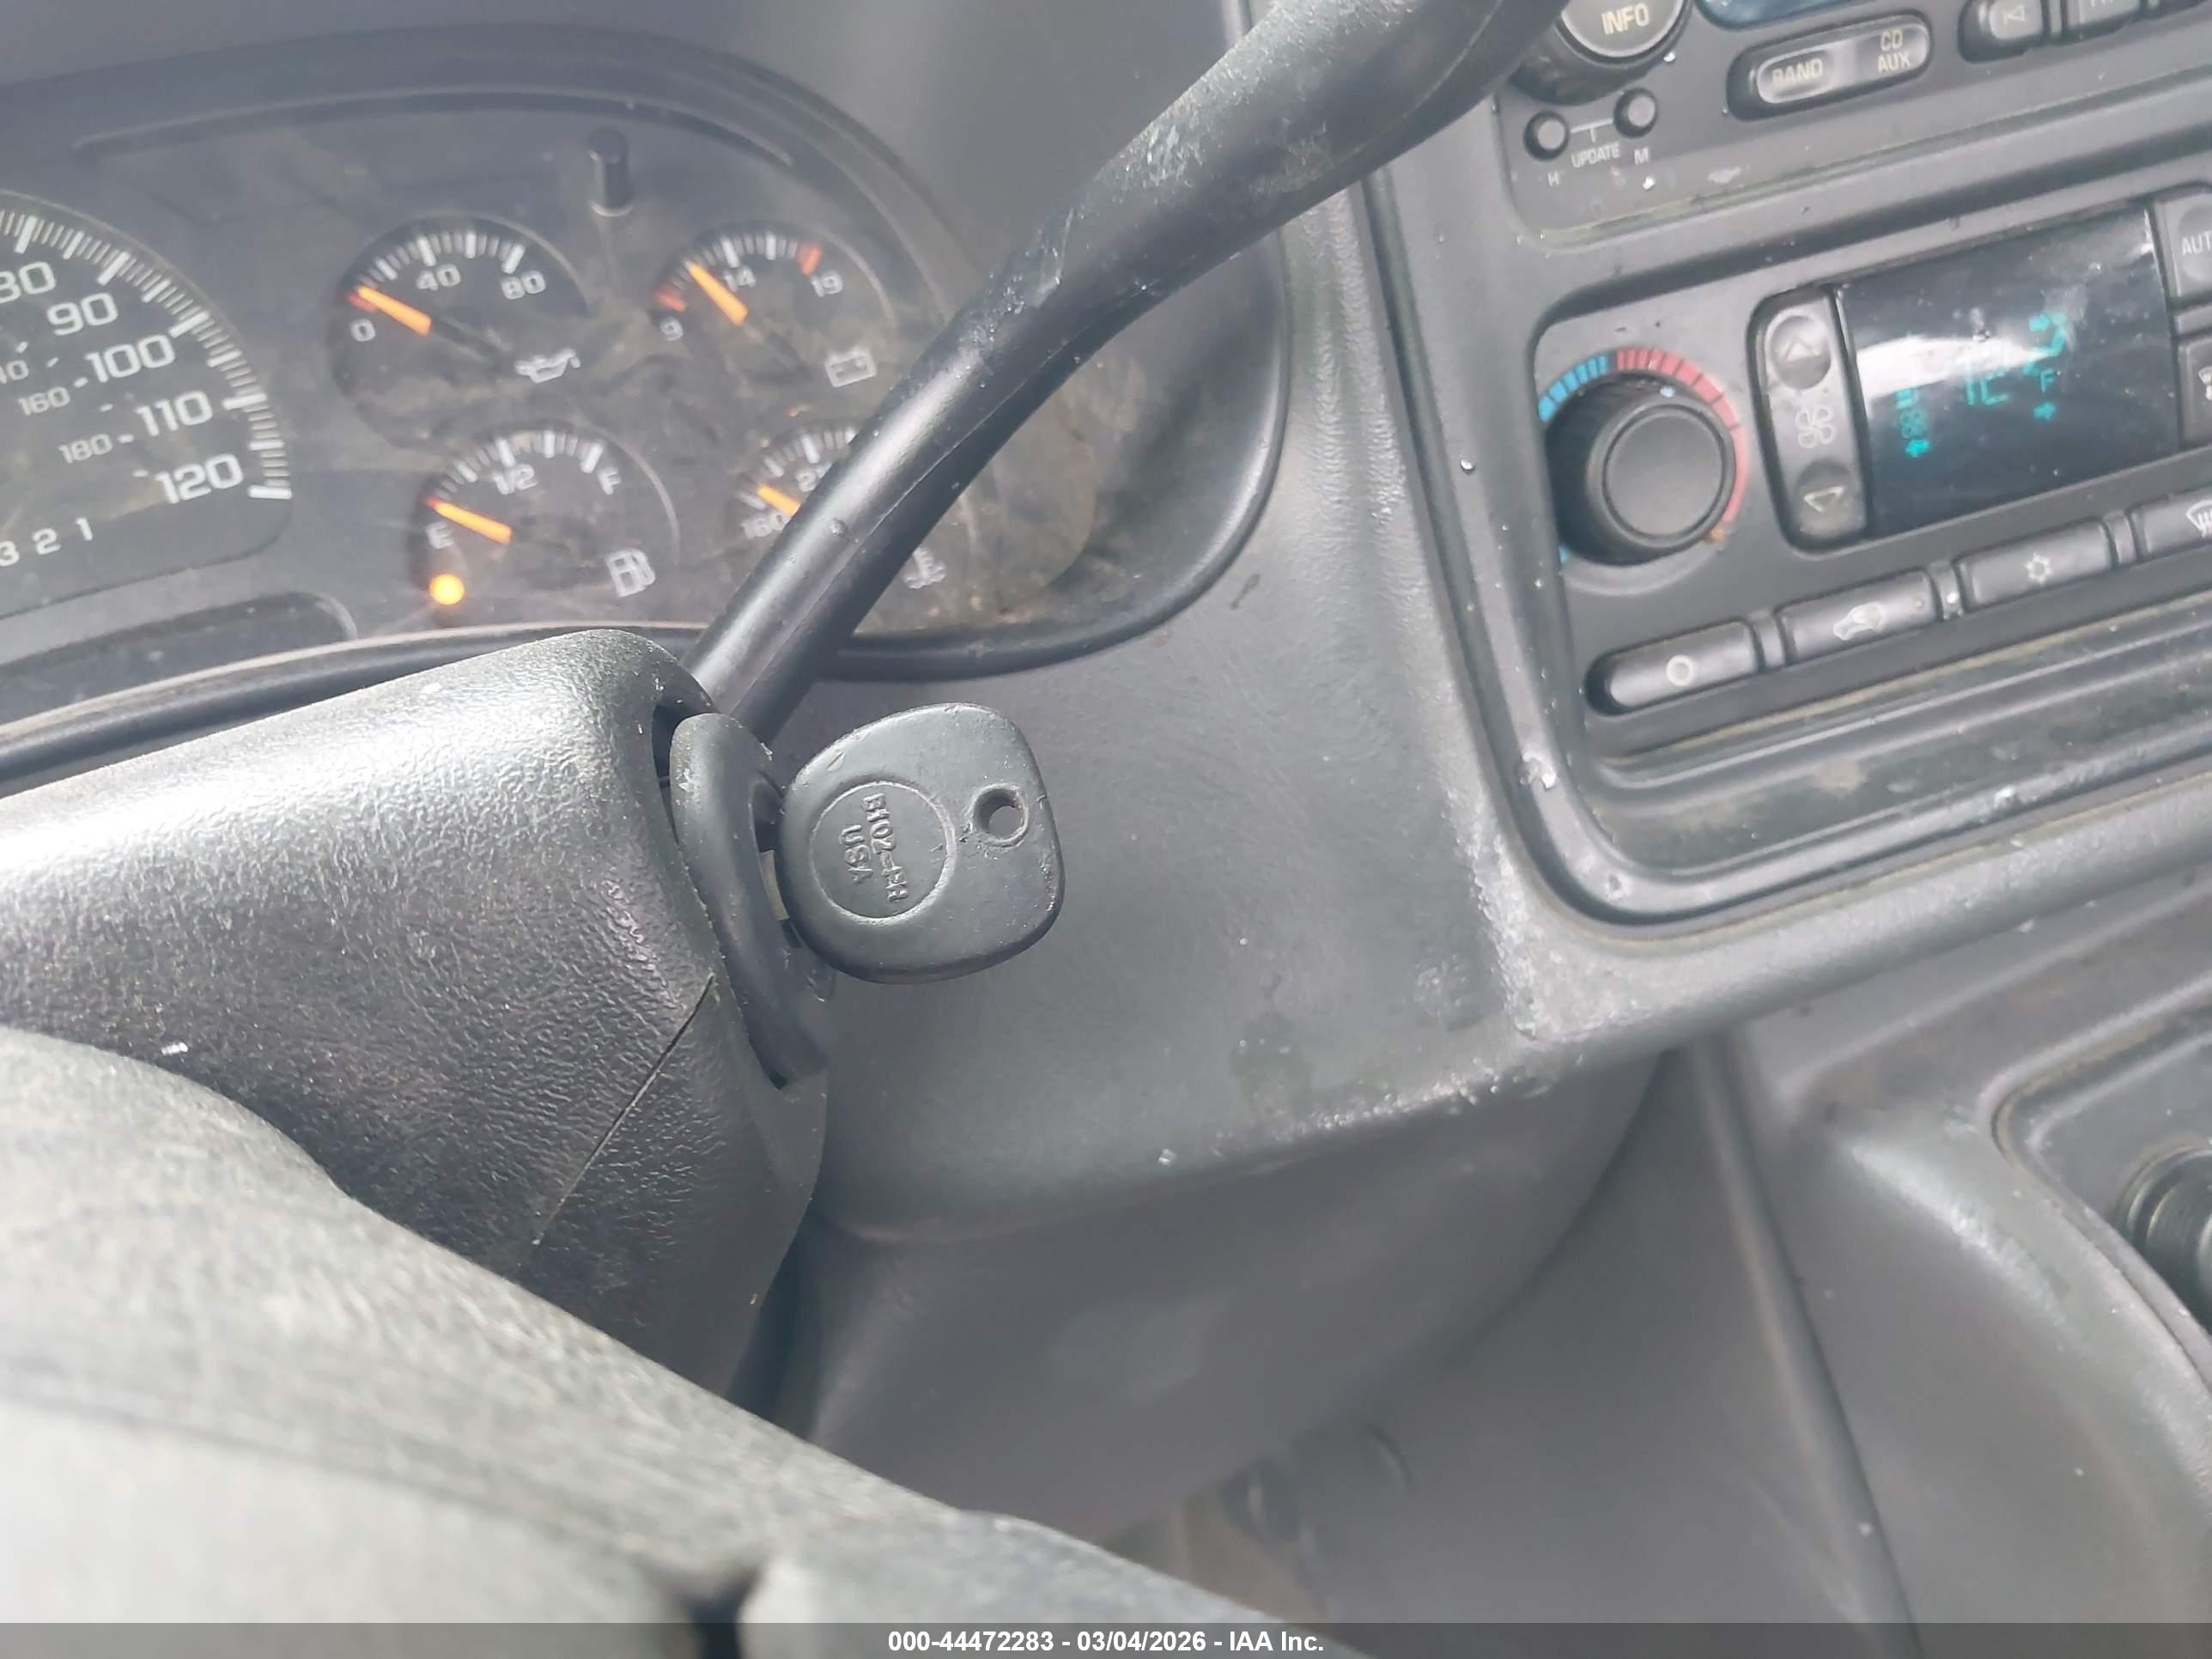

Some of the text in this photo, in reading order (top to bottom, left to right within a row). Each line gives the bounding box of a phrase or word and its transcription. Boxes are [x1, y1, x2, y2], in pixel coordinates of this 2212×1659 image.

[1601, 3, 1650, 35] INFO
[1881, 28, 1903, 52] CD
[1771, 58, 1824, 86] BAND
[1877, 51, 1911, 74] AUX
[1571, 143, 1621, 168] UPDATE
[1633, 148, 1650, 165] M
[1547, 172, 1559, 186] H
[416, 264, 461, 291] 40
[723, 266, 757, 293] 14
[811, 270, 843, 297] 19
[46, 292, 118, 336] 90
[350, 319, 376, 342] 0
[659, 316, 684, 341] 9
[84, 333, 177, 383] 100
[17, 386, 70, 416] 160
[136, 391, 214, 436] 110
[58, 434, 113, 464] 180
[155, 453, 244, 504] 120
[598, 466, 622, 495] F
[33, 528, 61, 555] 2
[75, 517, 94, 541] 1
[427, 521, 454, 550] E
[841, 824, 873, 884] USA
